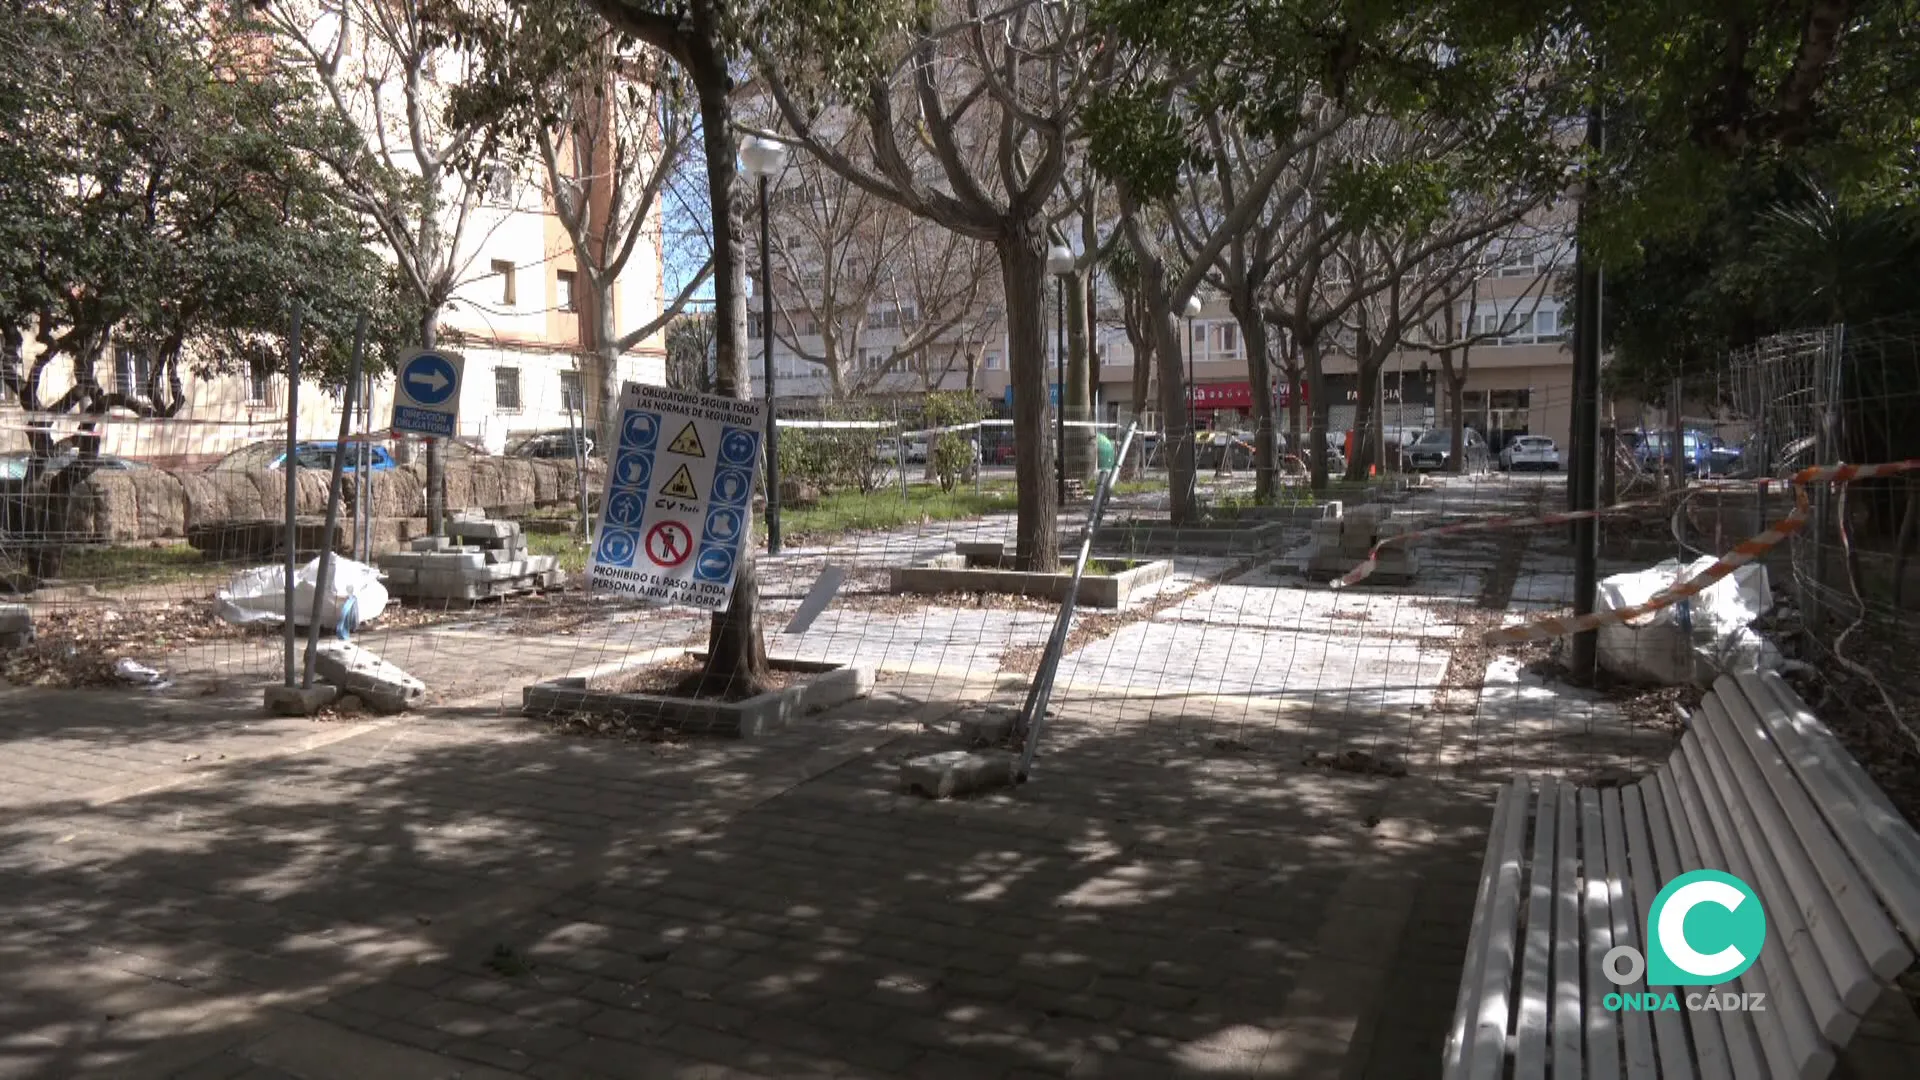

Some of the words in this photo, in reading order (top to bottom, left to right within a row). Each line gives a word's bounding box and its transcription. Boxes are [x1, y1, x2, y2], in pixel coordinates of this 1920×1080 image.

[631, 385, 641, 395] ES
[642, 387, 698, 404] OBLIGATORIO
[701, 397, 731, 410] SEGUIR
[732, 402, 760, 416] TODAS
[1347, 389, 1400, 400] FACIA
[395, 416, 450, 433] OBLIGATORIA
[637, 399, 652, 409] LAS
[655, 402, 690, 416] NORMAS
[691, 407, 702, 417] DE
[704, 410, 752, 426] SEGURIDAD
[592, 577, 636, 593] PERSONA
[638, 583, 669, 597] AJENA
[670, 590, 678, 600] A
[680, 591, 692, 602] LA
[694, 594, 722, 607] OBRA
[593, 565, 648, 582] PROHIBIDO
[650, 576, 660, 586] EL
[663, 576, 688, 590] PASO
[690, 582, 697, 593] A
[700, 584, 726, 596] TODA
